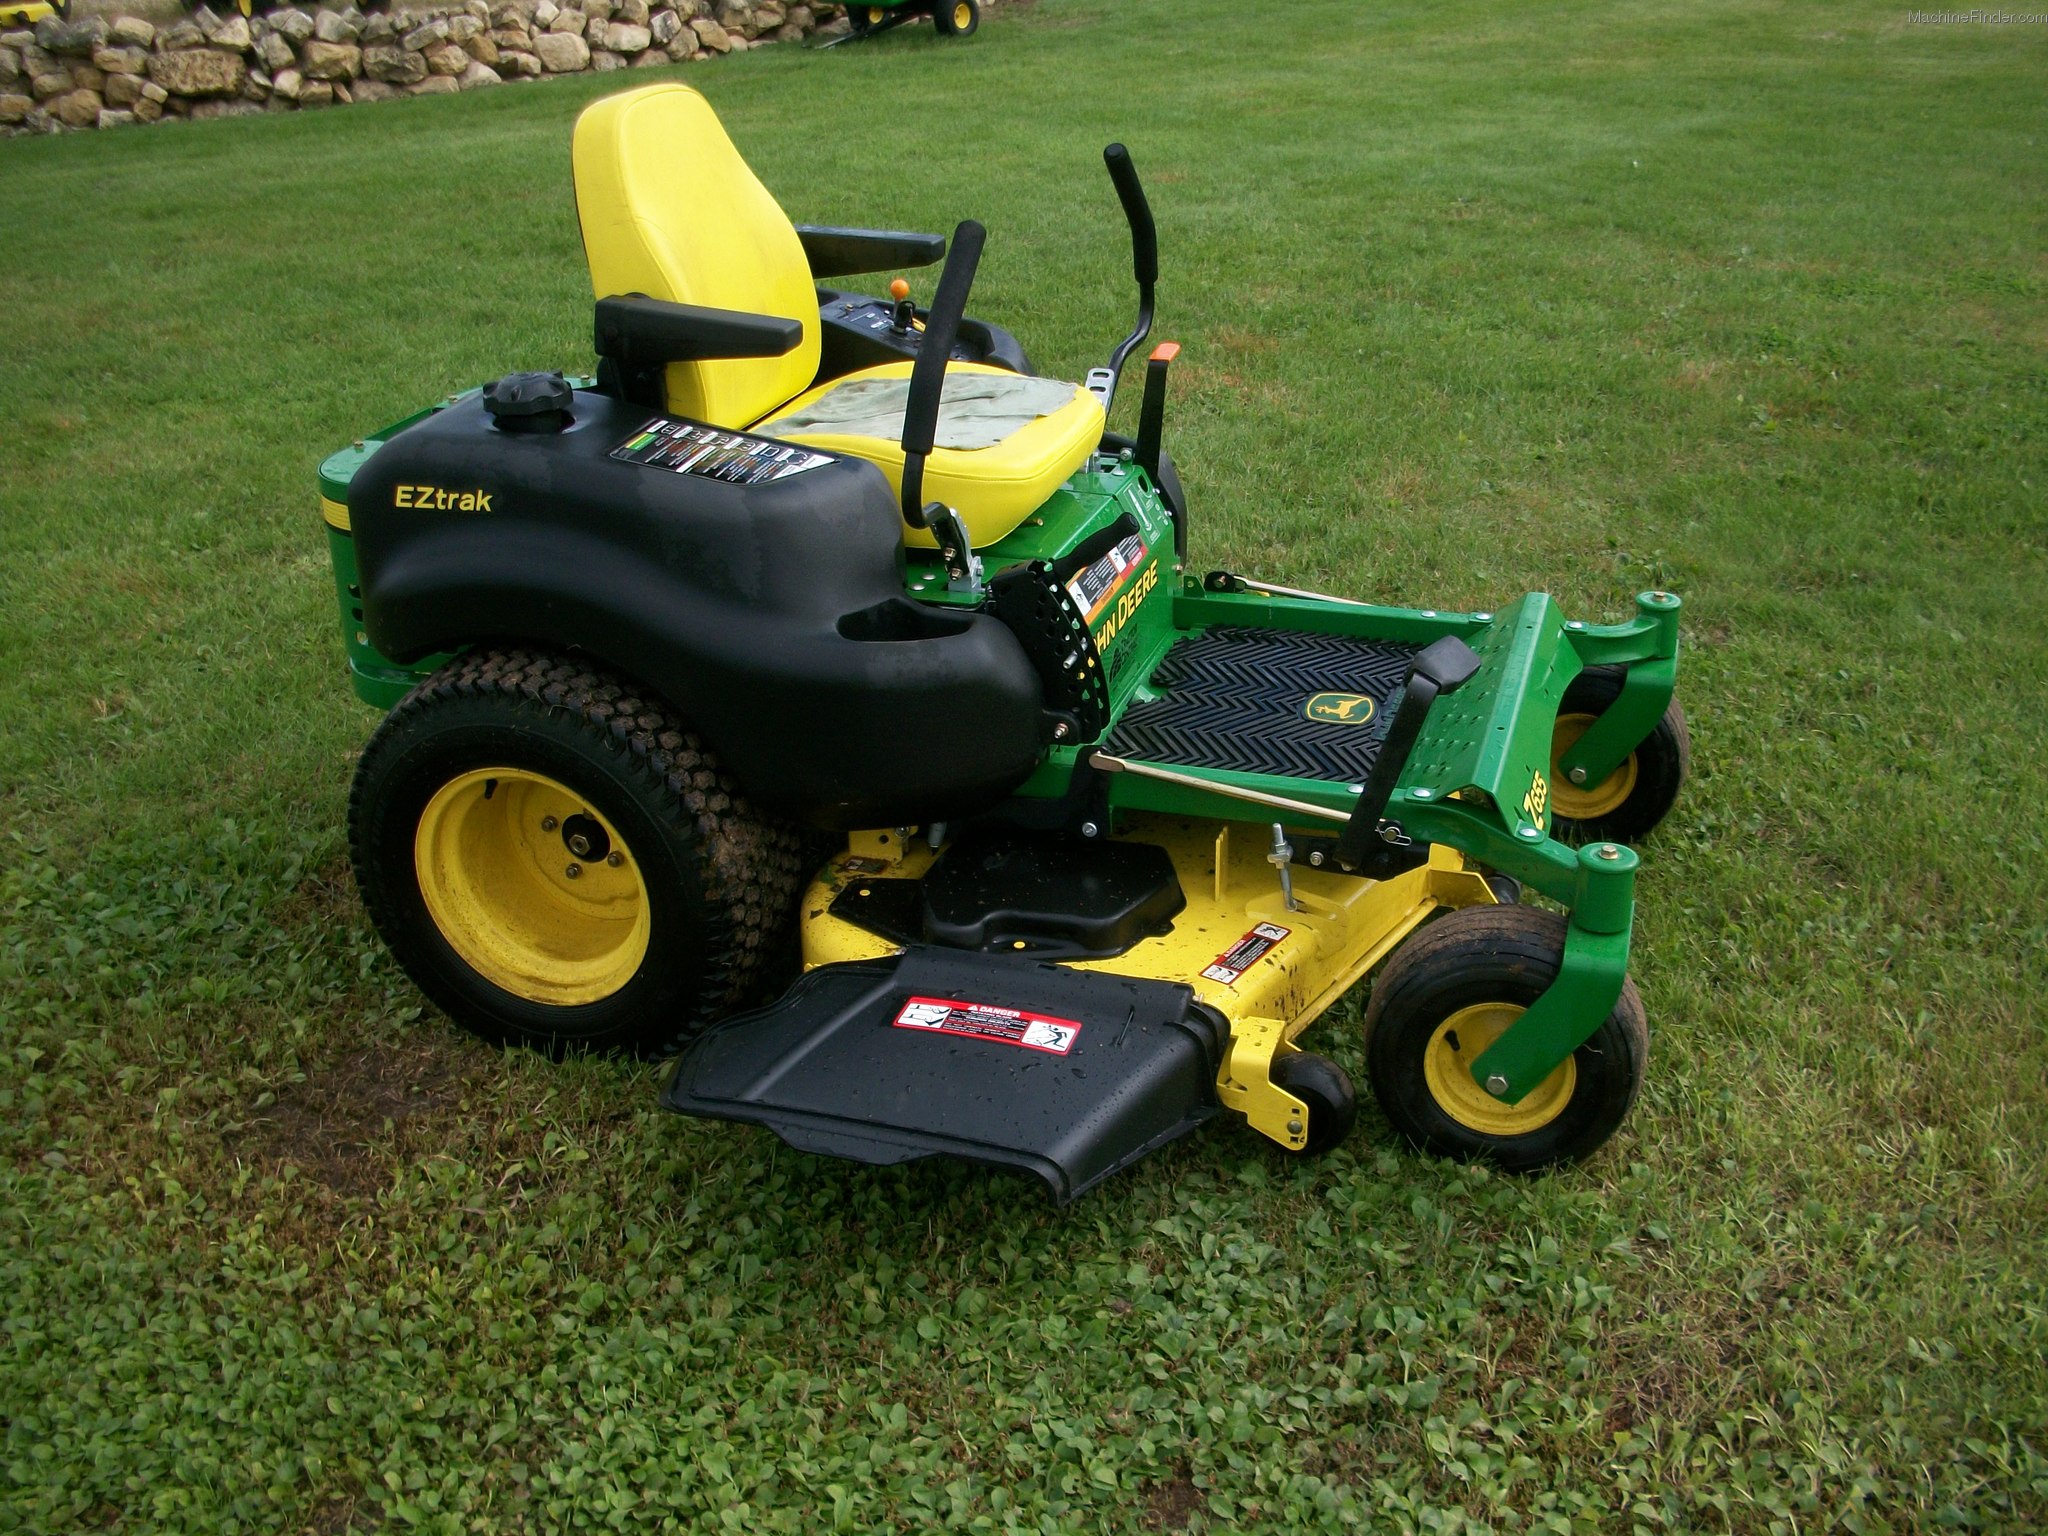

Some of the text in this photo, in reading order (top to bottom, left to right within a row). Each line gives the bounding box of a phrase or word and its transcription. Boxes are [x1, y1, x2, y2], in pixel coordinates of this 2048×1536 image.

[395, 485, 493, 512] EZtrak
[1093, 611, 1116, 656] HN
[1118, 558, 1158, 630] DEERE
[1523, 769, 1547, 830] Z655
[979, 1005, 1021, 1018] DANGER
